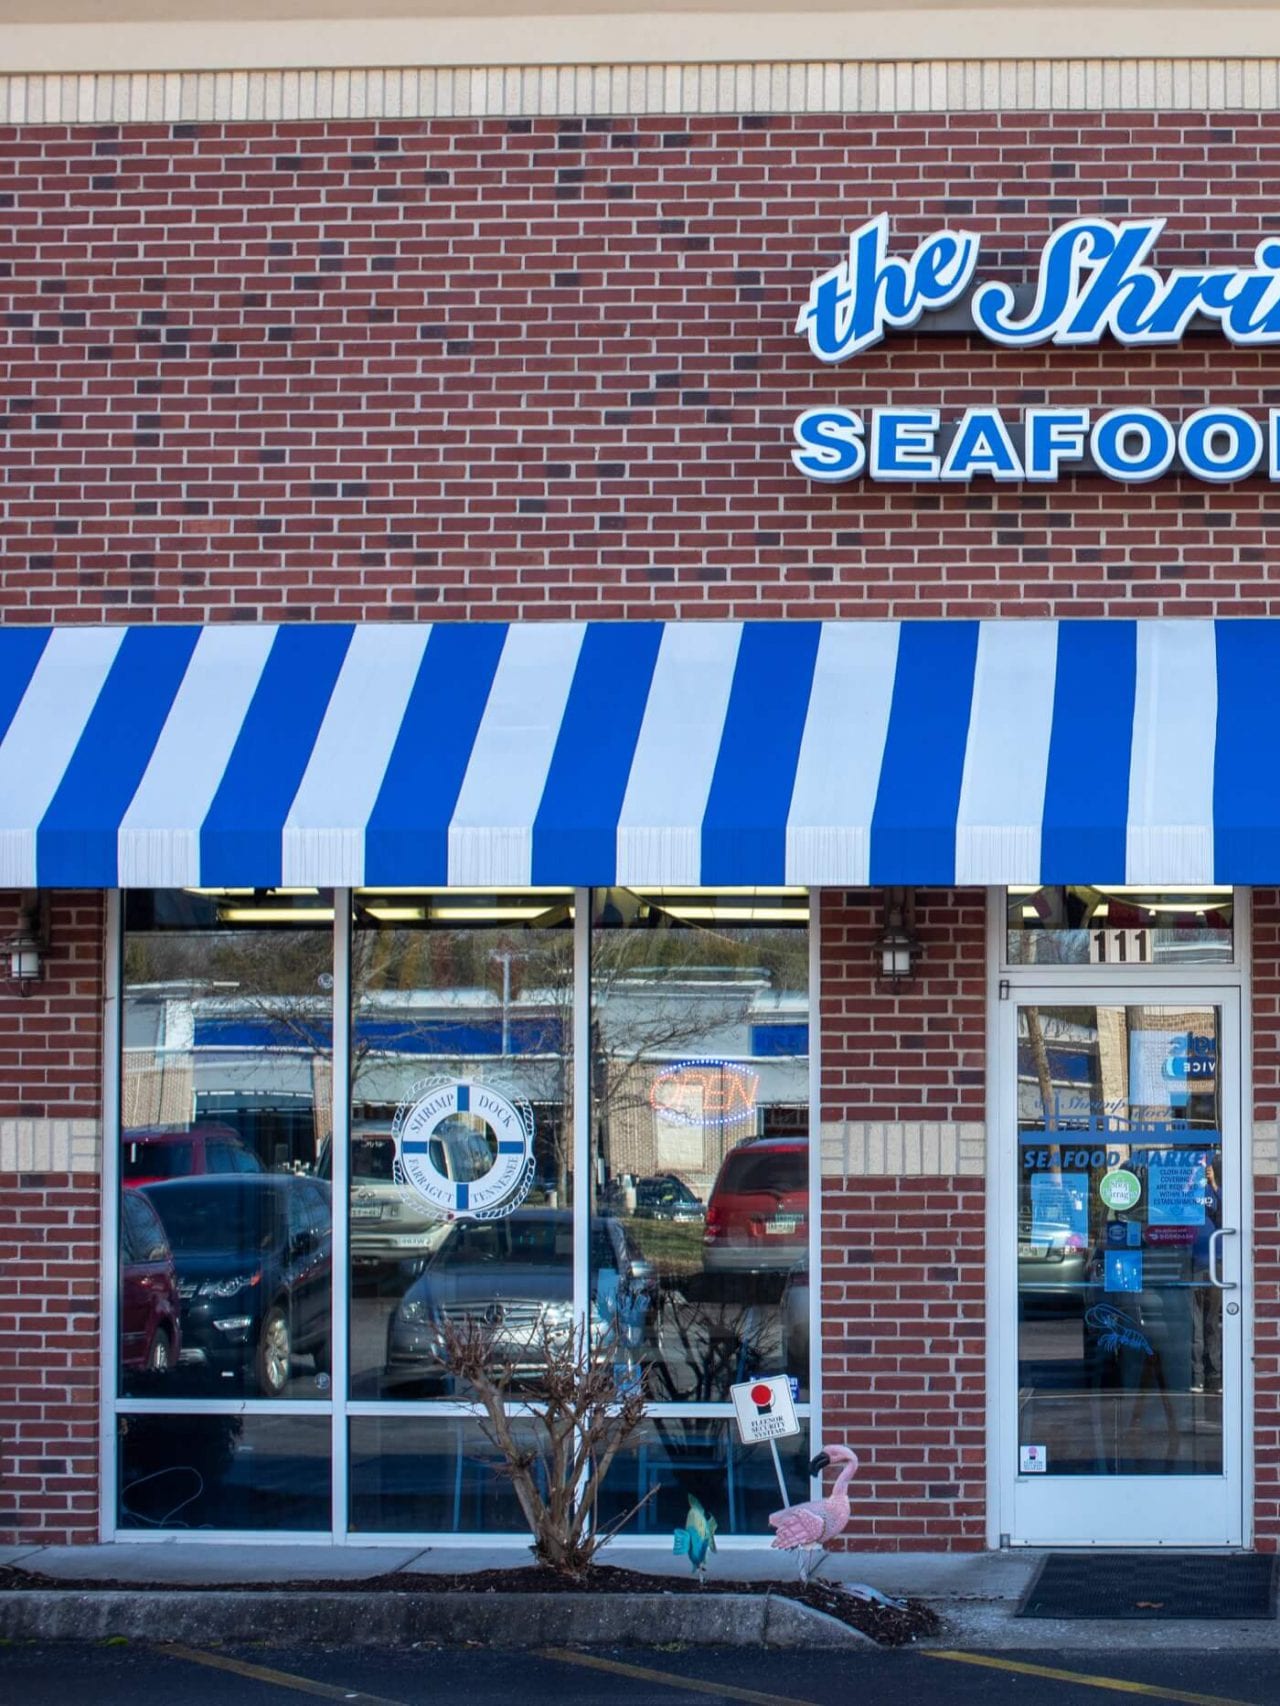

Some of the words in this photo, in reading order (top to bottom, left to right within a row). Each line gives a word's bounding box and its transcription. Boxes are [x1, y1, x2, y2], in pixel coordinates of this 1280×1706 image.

[796, 213, 980, 365] the
[1094, 930, 1146, 962] 111
[650, 1073, 760, 1111] OPEN
[411, 1094, 454, 1134] SHRIMP
[479, 1095, 515, 1128] DOCK
[1024, 1151, 1121, 1168] SEAFOOD
[1130, 1150, 1216, 1168] MARKET
[408, 1157, 454, 1202] FARRAGUT
[470, 1156, 519, 1202] TENNESSEE
[751, 1421, 785, 1433] SECURITY
[754, 1428, 786, 1438] SYSTEMS
